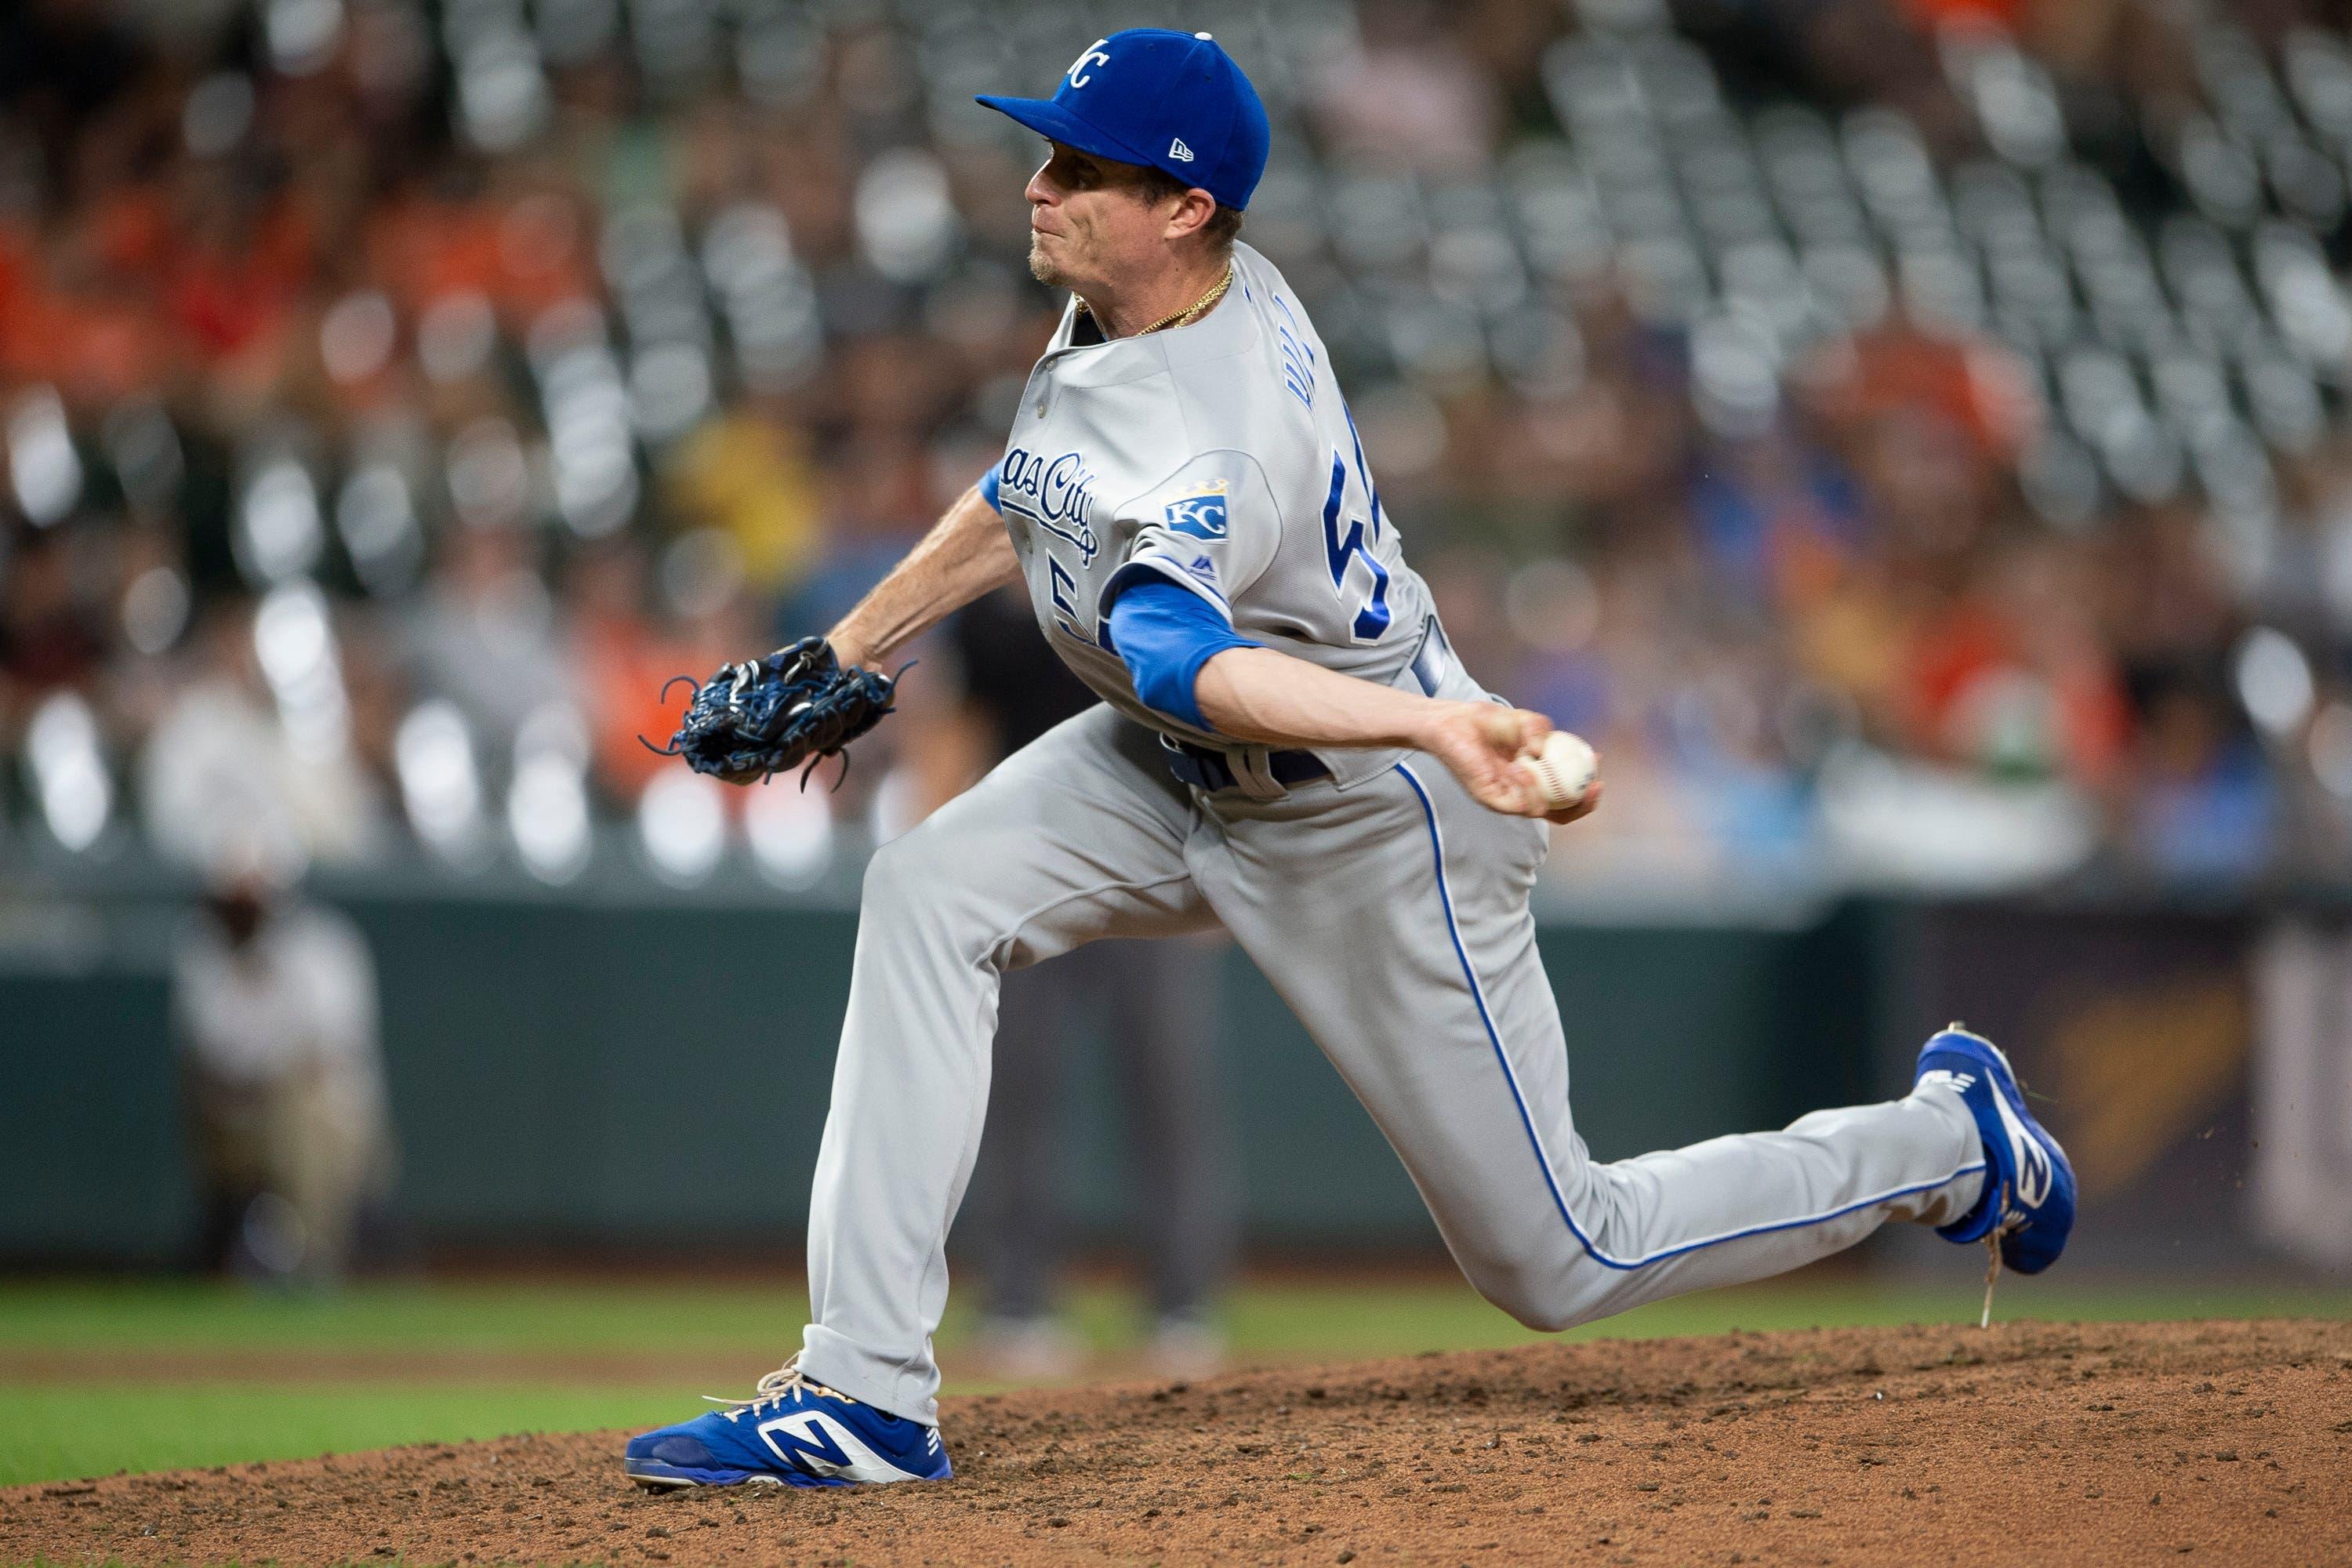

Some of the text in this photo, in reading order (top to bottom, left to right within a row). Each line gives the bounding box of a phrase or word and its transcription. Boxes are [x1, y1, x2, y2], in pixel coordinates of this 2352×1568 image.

[1040, 451, 1099, 568] City
[1165, 500, 1226, 535] KC
[766, 1419, 854, 1473] N
